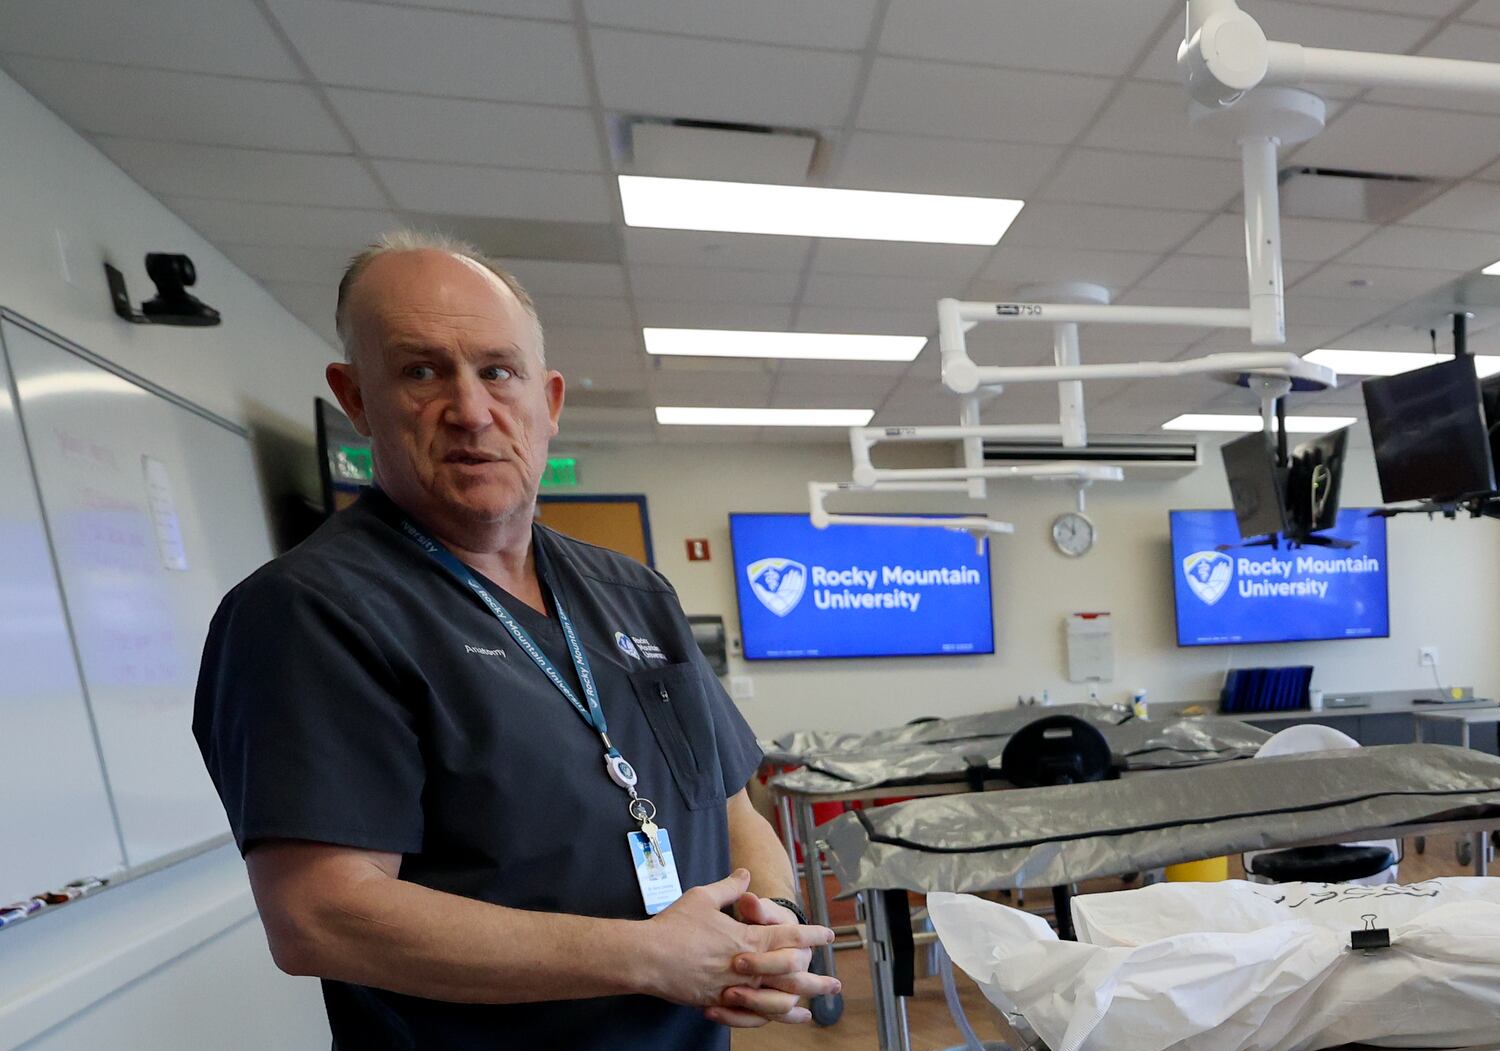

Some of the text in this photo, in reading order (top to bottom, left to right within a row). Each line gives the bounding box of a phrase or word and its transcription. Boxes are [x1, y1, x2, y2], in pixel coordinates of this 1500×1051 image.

[812, 565, 980, 589] Rocky Mountain
[1237, 555, 1379, 578] Rocky Mountain
[1238, 578, 1328, 598] University
[813, 589, 921, 612] University
[479, 589, 507, 620] Rocky
[505, 618, 547, 668] Mountain
[464, 643, 507, 658] Anatomy
[580, 666, 594, 696] Rocky
